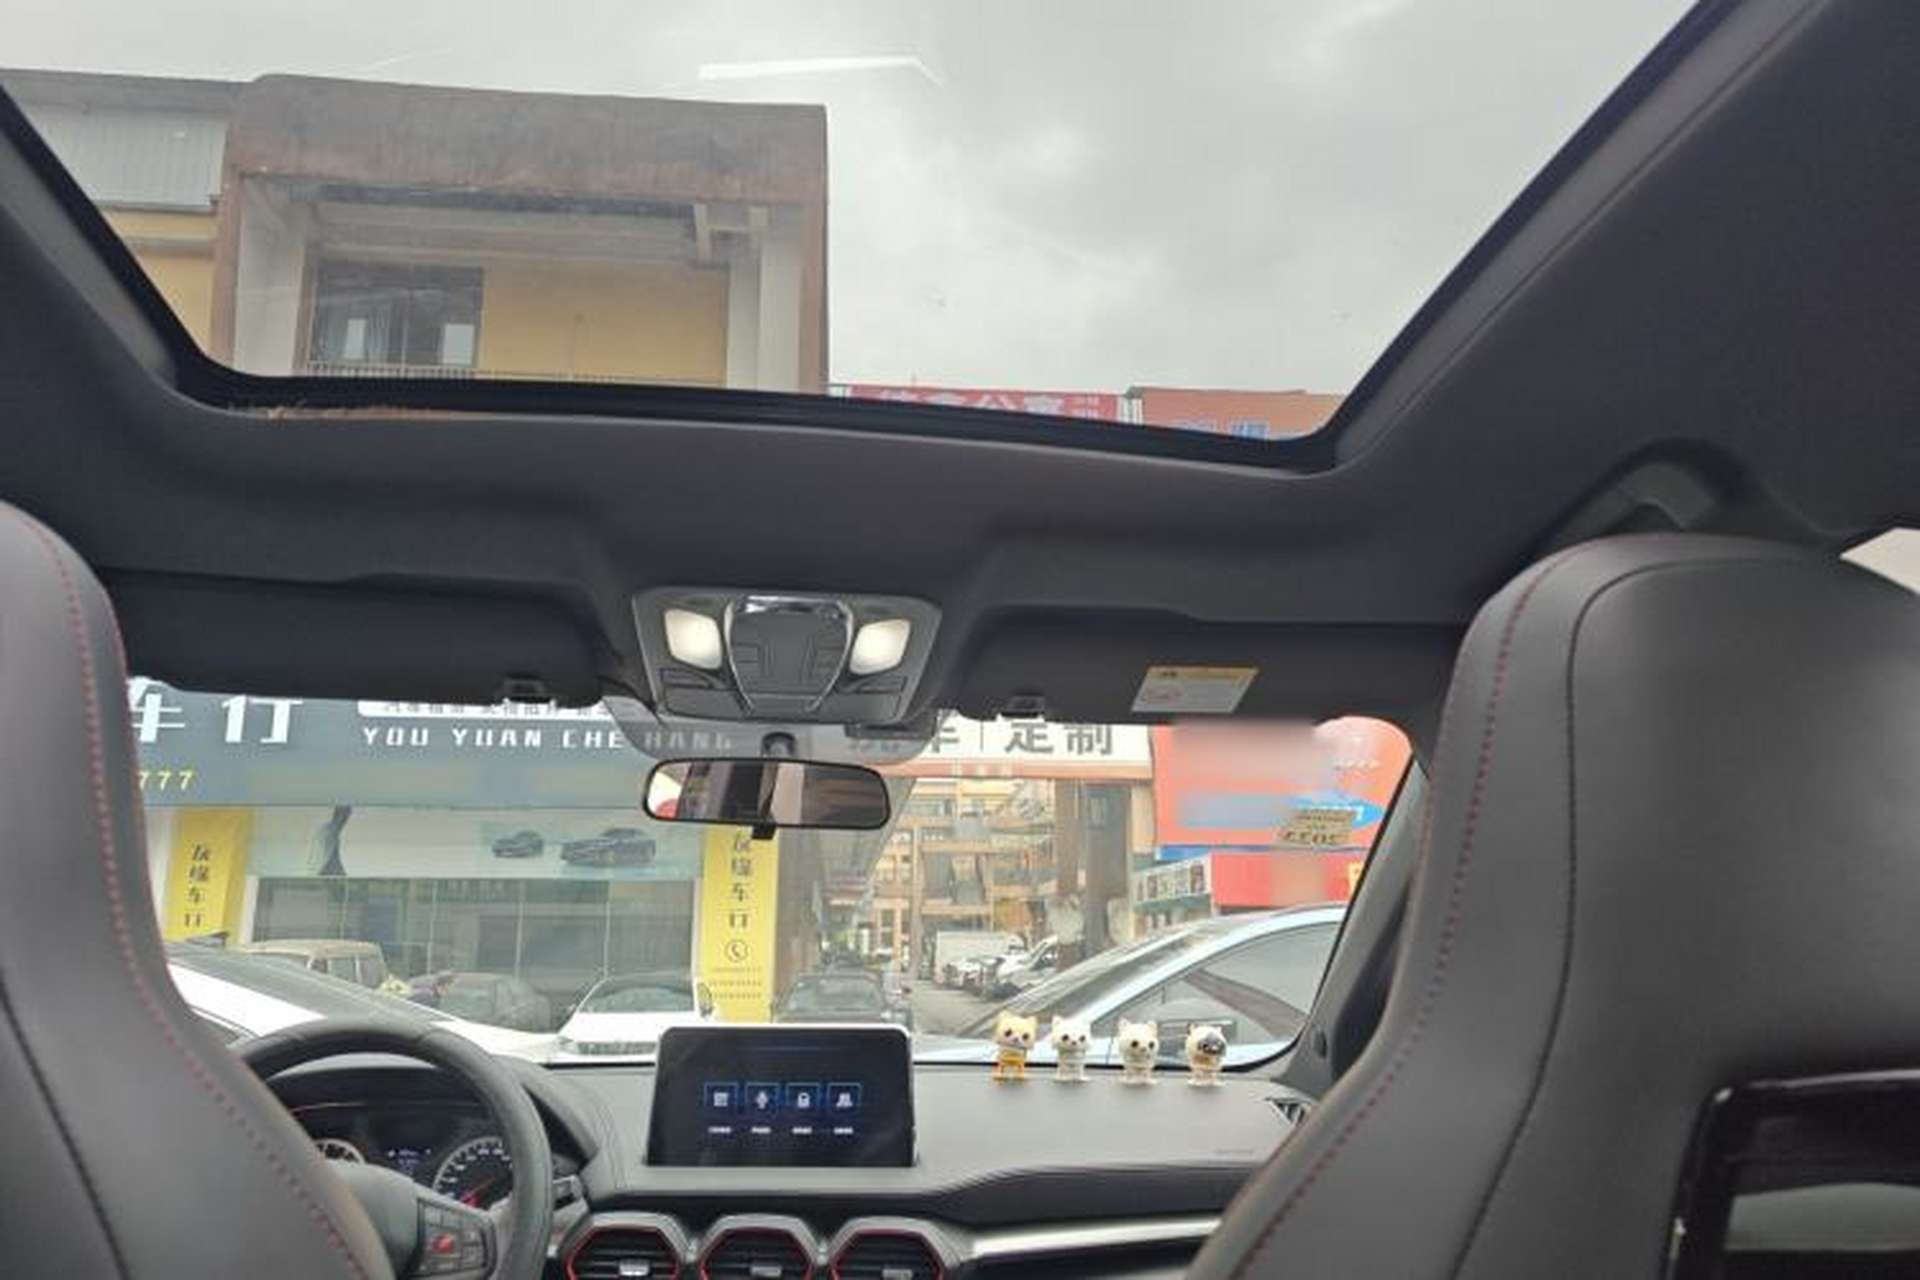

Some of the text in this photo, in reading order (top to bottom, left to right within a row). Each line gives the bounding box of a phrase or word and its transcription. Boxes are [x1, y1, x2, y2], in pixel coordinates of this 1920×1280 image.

[363, 726, 429, 746] YOU
[451, 728, 543, 748] YUAN
[562, 729, 625, 749] CHE
[1005, 721, 1111, 755] 定制
